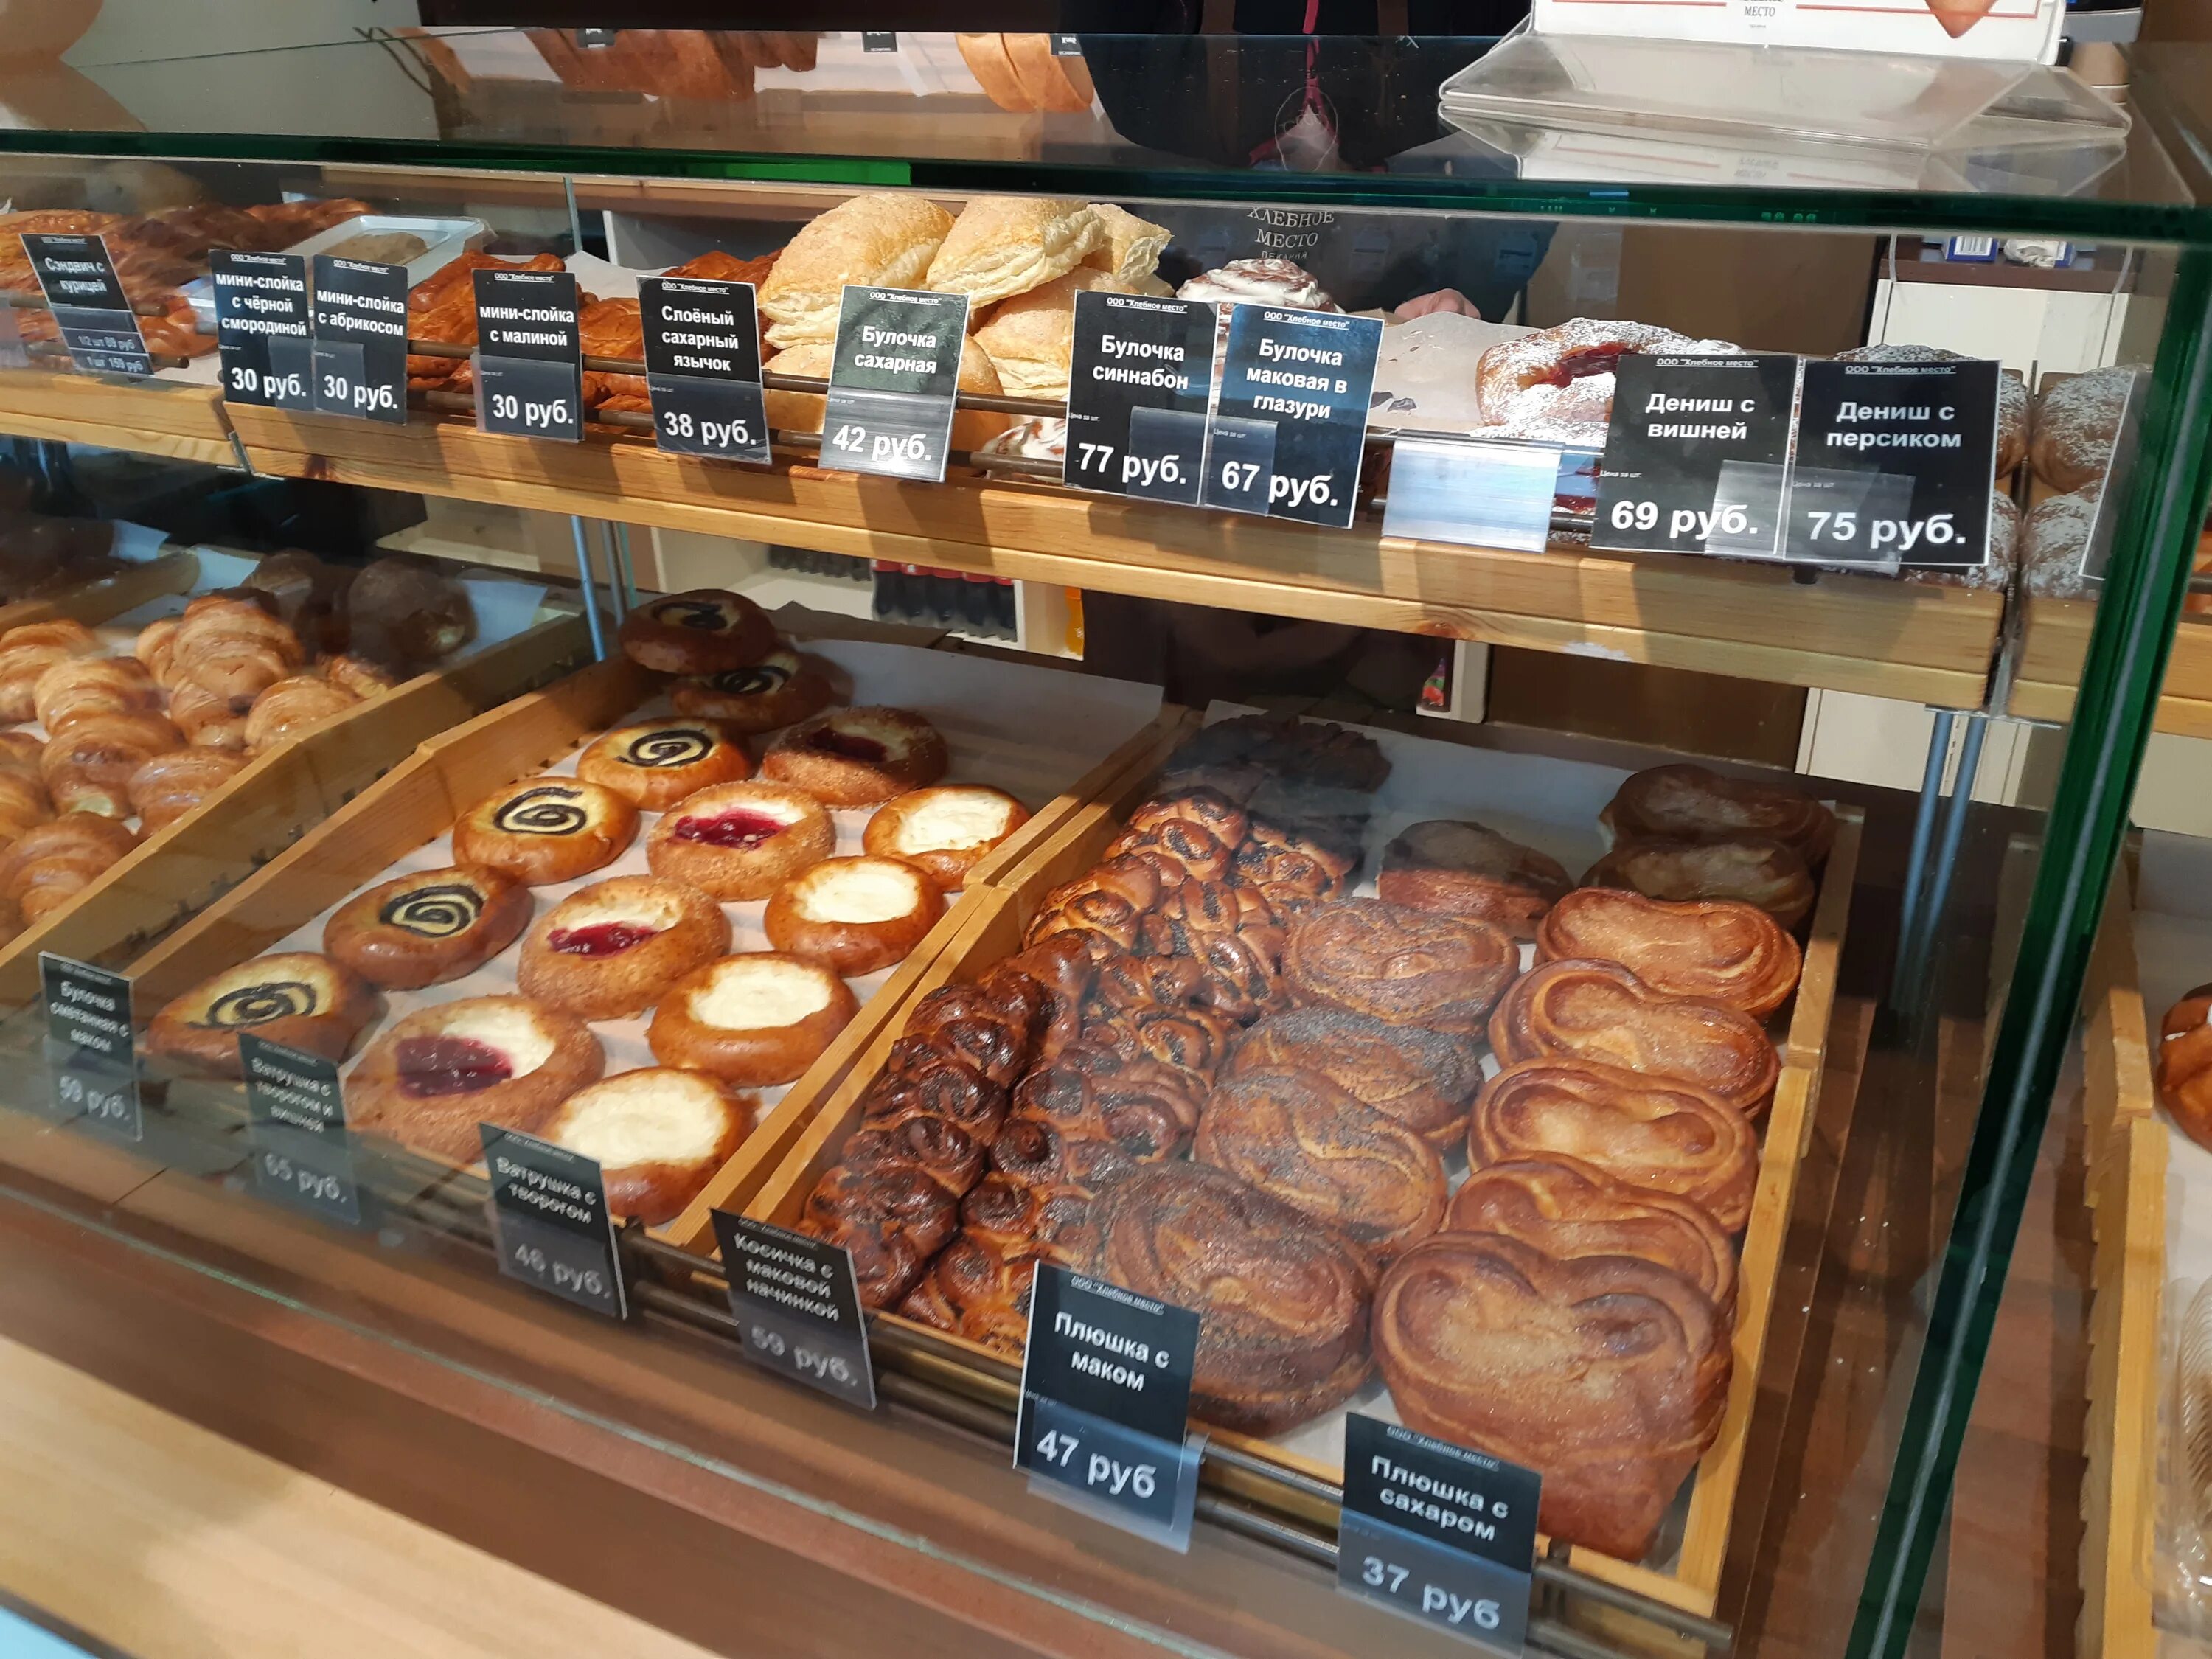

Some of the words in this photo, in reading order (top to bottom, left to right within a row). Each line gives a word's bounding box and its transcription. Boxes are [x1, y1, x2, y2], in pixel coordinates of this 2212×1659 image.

[1745, 6, 1776, 17] МЕСТО
[1255, 228, 1318, 248] МЕСТО
[44, 257, 96, 274] Сэндвич
[97, 262, 105, 273] с
[59, 279, 108, 294] курицей
[215, 274, 305, 291] мини-слойка
[869, 291, 886, 299] ООО
[232, 296, 241, 308] с
[244, 295, 293, 313] чёрной
[316, 290, 405, 314] мини-слойка
[479, 306, 575, 323] мини-слойка
[1107, 297, 1124, 306] ООО
[221, 317, 307, 335] смородиной
[318, 312, 327, 324] с
[330, 313, 403, 336] абрикосом
[661, 305, 734, 326] Слоёный
[1264, 310, 1282, 321] ООО
[490, 330, 499, 342] с
[502, 330, 568, 347] малиной
[661, 331, 739, 349] сахарный
[862, 325, 937, 349] Булочка
[1102, 335, 1184, 361] Булочка
[673, 355, 731, 371] язычок
[854, 353, 937, 374] сахарная
[1259, 338, 1343, 366] Булочка
[1093, 365, 1189, 390] синнабон
[1246, 367, 1329, 392] маковая
[1335, 379, 1348, 394] в
[1846, 365, 1869, 373] ООО
[231, 367, 257, 392] 30
[262, 373, 307, 400] руб.
[324, 375, 348, 400] 30
[353, 385, 398, 411] руб.
[492, 394, 518, 420] 30
[525, 399, 574, 428] руб.
[1253, 394, 1331, 421] глазури
[1645, 393, 1733, 414] Дениш
[1740, 399, 1756, 412] с
[1836, 402, 1930, 423] Дениш
[1938, 406, 1955, 420] с
[664, 411, 694, 438] 38
[700, 419, 757, 448] руб.
[1647, 422, 1747, 439] вишней
[1826, 432, 1962, 451] персиком
[832, 425, 866, 453] 42
[872, 433, 932, 462] руб.
[1079, 442, 1114, 473] 77
[1121, 454, 1186, 487] руб.
[1222, 460, 1261, 493] 67
[1268, 473, 1338, 507] руб.
[1611, 500, 1659, 531] 69
[1669, 504, 1758, 540] руб.
[1808, 511, 1857, 541] 75
[1870, 513, 1966, 551] руб.
[321, 1083, 331, 1096] с
[87, 1090, 131, 1121] руб.
[298, 1169, 347, 1204] руб.
[496, 1155, 582, 1200] Ватрушка
[584, 1191, 597, 1206] с
[508, 1182, 592, 1225] творогом
[734, 1233, 816, 1273] Косичка
[820, 1264, 834, 1279] с
[554, 1260, 611, 1299] руб.
[746, 1259, 831, 1298] маковой
[746, 1279, 840, 1322] начинкой
[1053, 1310, 1150, 1363] Плюшка
[1154, 1350, 1170, 1369] с
[794, 1346, 858, 1387] руб.
[1071, 1351, 1145, 1392] маком
[1036, 1429, 1080, 1467] 47
[1087, 1452, 1158, 1499] руб
[1371, 1455, 1485, 1512] Плюшка
[1492, 1500, 1509, 1519] с
[1380, 1487, 1495, 1542] сахаром
[1362, 1556, 1410, 1594] 37
[1422, 1583, 1500, 1630] руб
